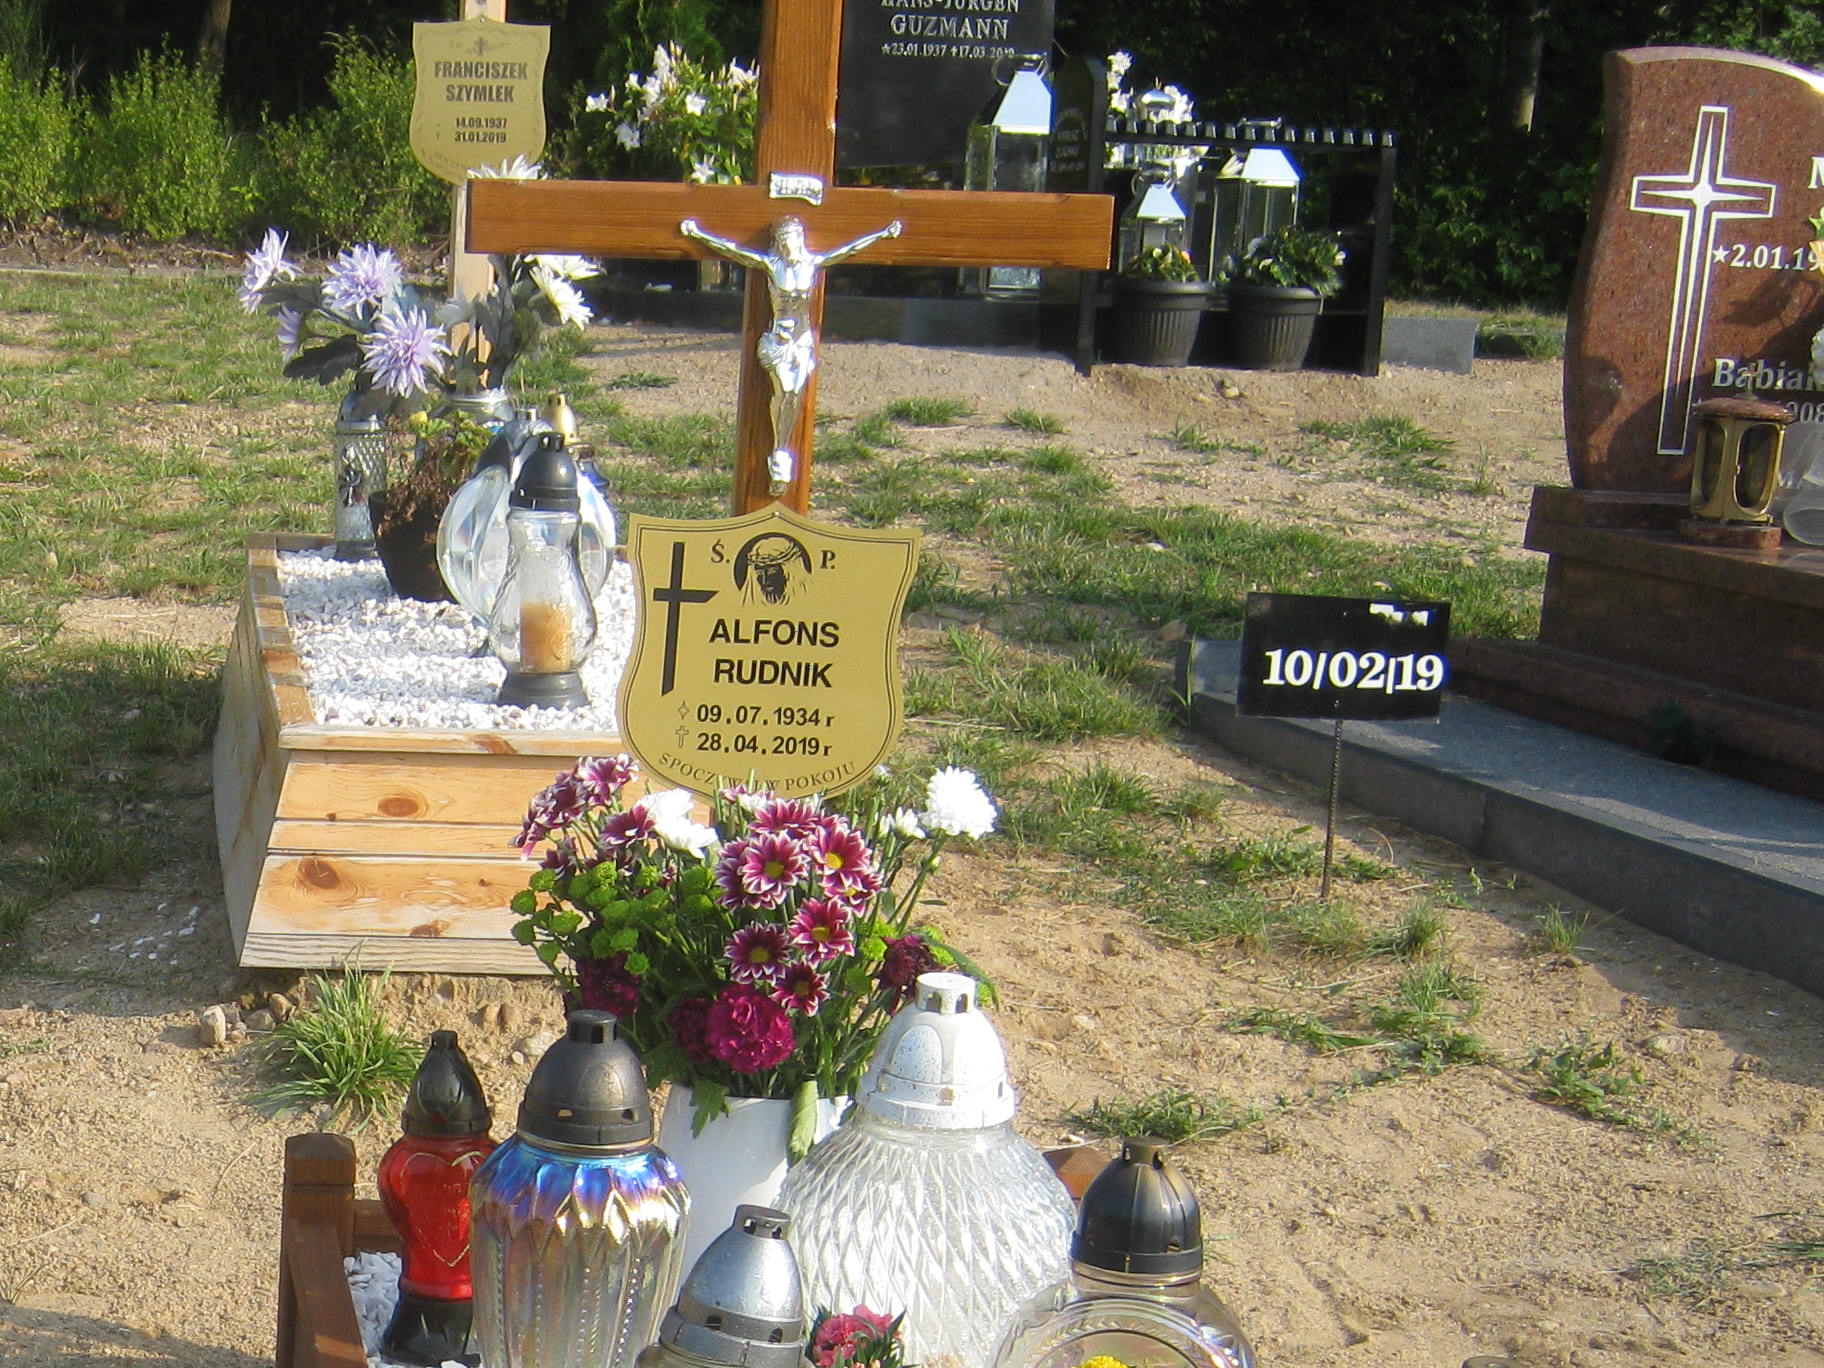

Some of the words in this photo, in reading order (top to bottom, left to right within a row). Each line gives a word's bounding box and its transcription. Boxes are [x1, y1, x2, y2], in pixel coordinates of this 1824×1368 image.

[889, 13, 1009, 40] GUZMANN
[434, 60, 528, 80] FRANCISZEK
[445, 84, 514, 103] SZYMLEK
[710, 538, 730, 564] Ś.
[819, 550, 836, 570] P.
[708, 618, 840, 648] ALFONS
[713, 658, 833, 688] RUDNIK
[659, 752, 758, 793] SPOCZWJ
[785, 760, 855, 791] POKOJU
